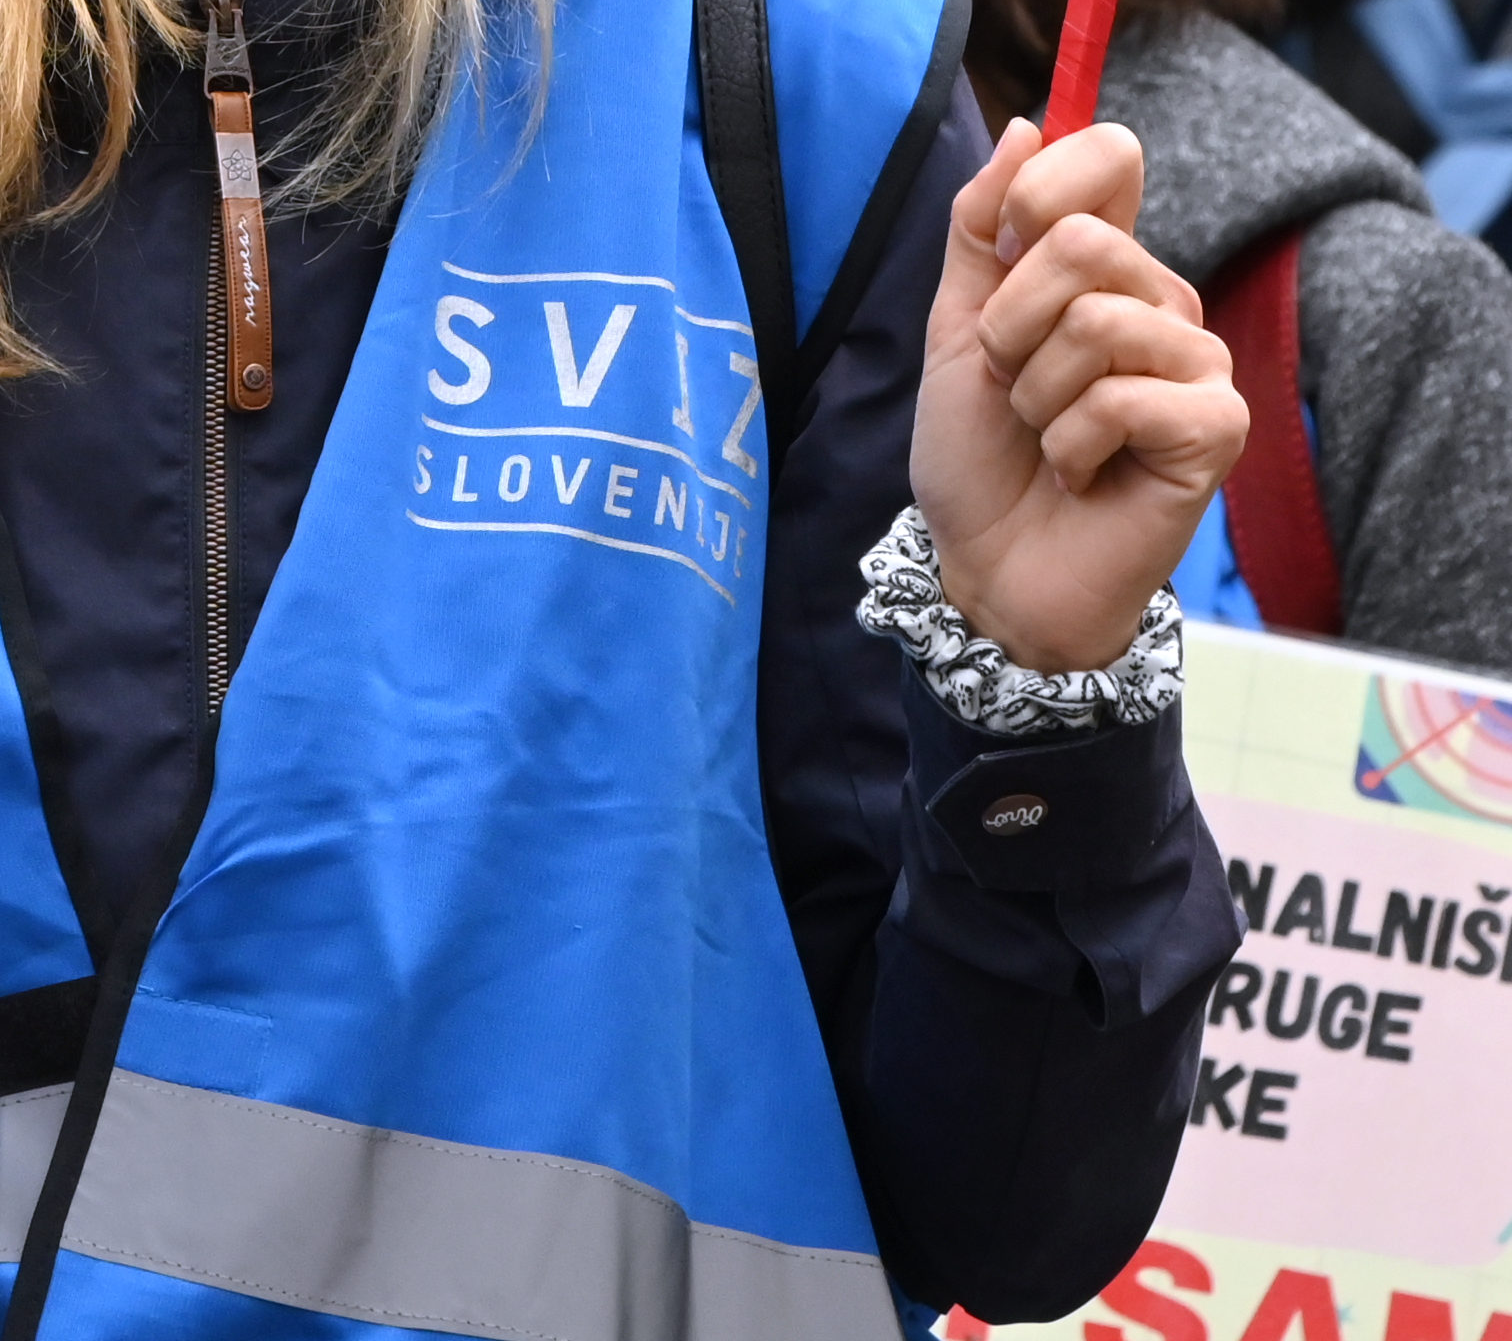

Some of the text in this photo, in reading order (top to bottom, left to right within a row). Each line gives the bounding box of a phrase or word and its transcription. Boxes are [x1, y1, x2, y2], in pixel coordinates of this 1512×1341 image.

[238, 215, 261, 326] ragwear
[427, 294, 760, 479] SVIZ
[412, 444, 748, 579] SLOVENIJE
